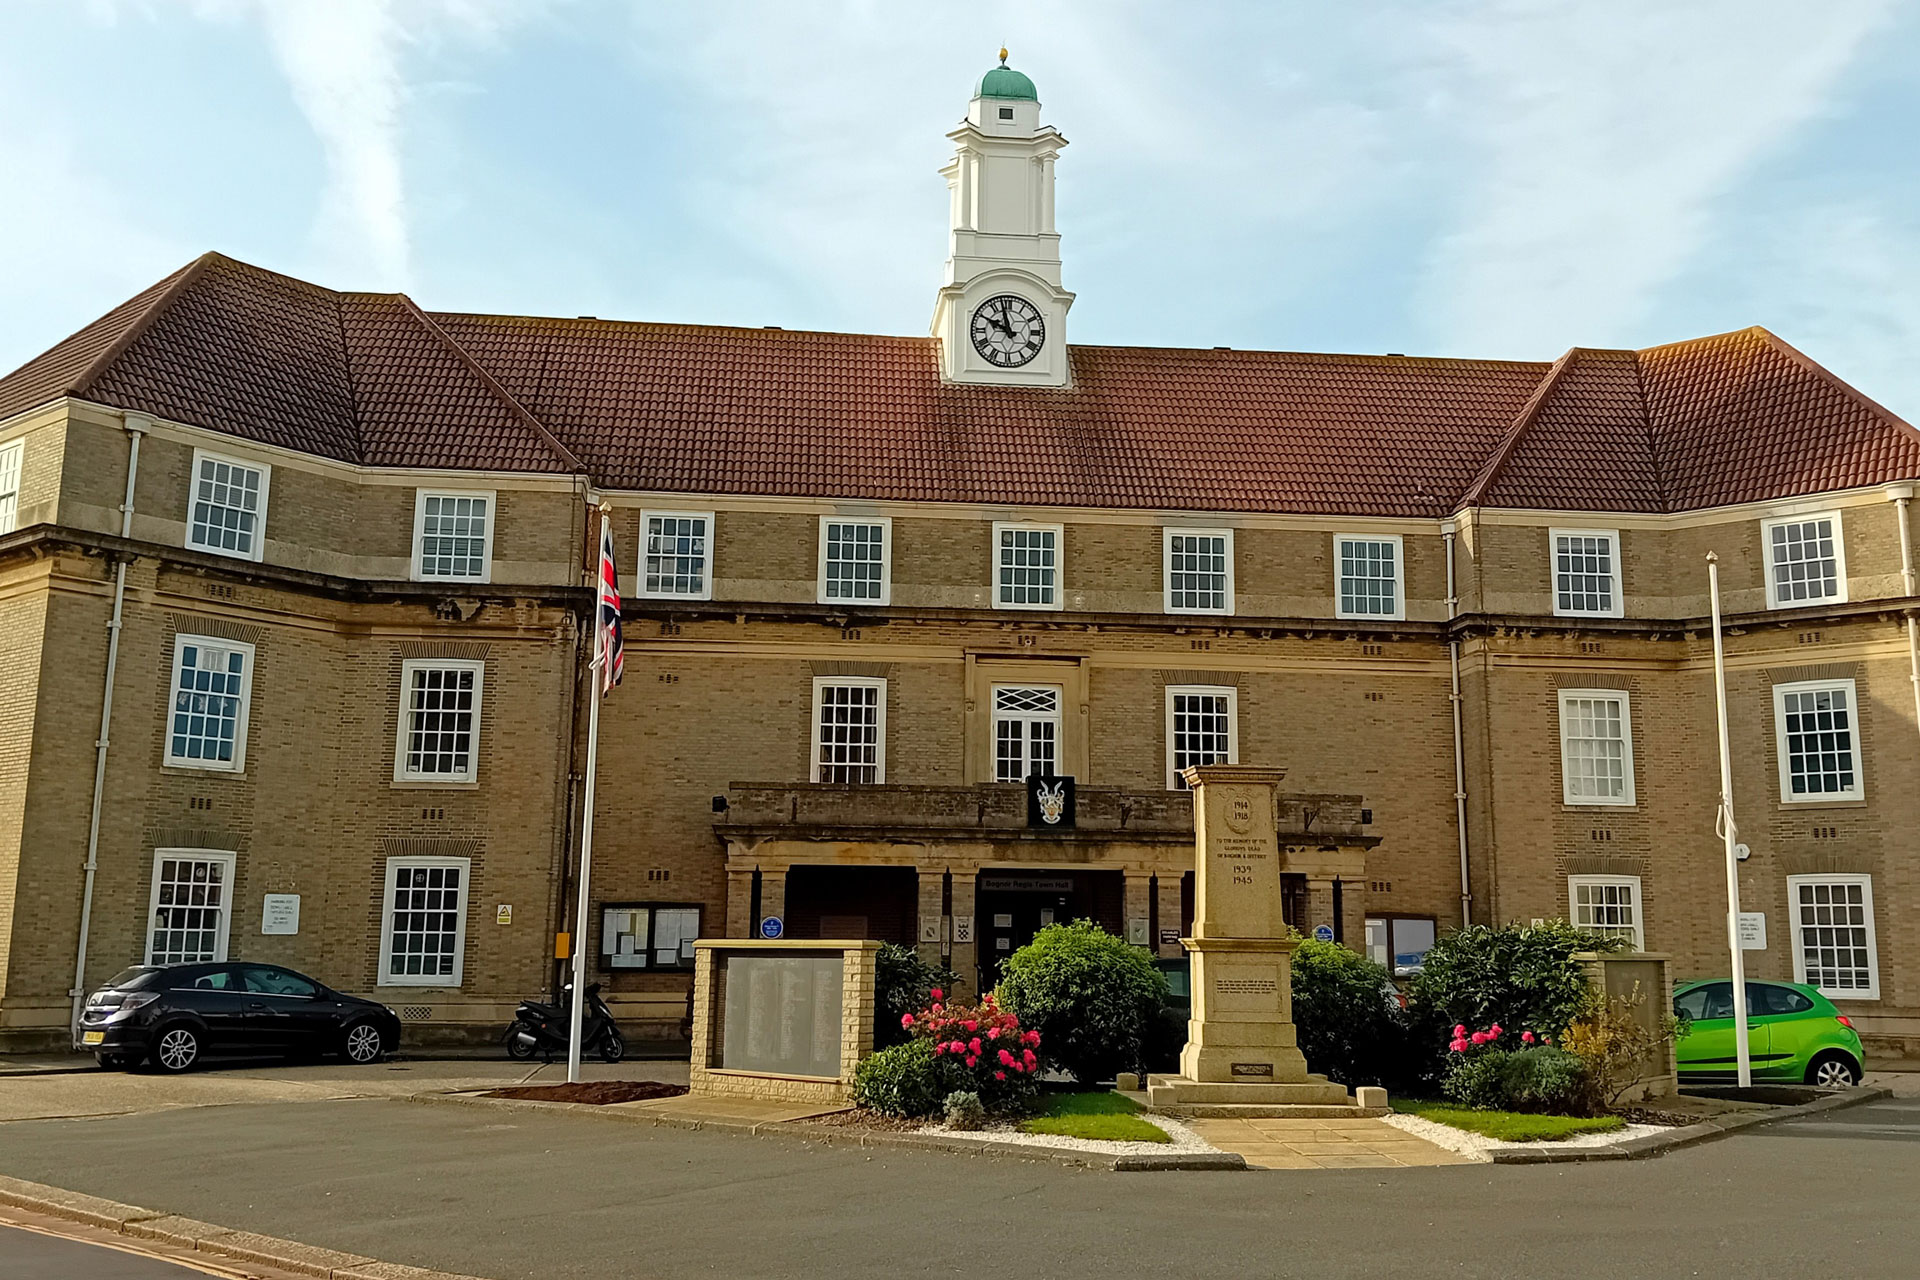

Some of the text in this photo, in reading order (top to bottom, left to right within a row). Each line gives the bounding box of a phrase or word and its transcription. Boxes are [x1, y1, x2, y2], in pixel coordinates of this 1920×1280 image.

[1234, 801, 1248, 810] 1914
[1234, 812, 1249, 820] 1918
[1233, 865, 1252, 874] 1939
[985, 880, 1069, 889] Bognor Regis Town Hall
[1233, 876, 1253, 885] 1945
